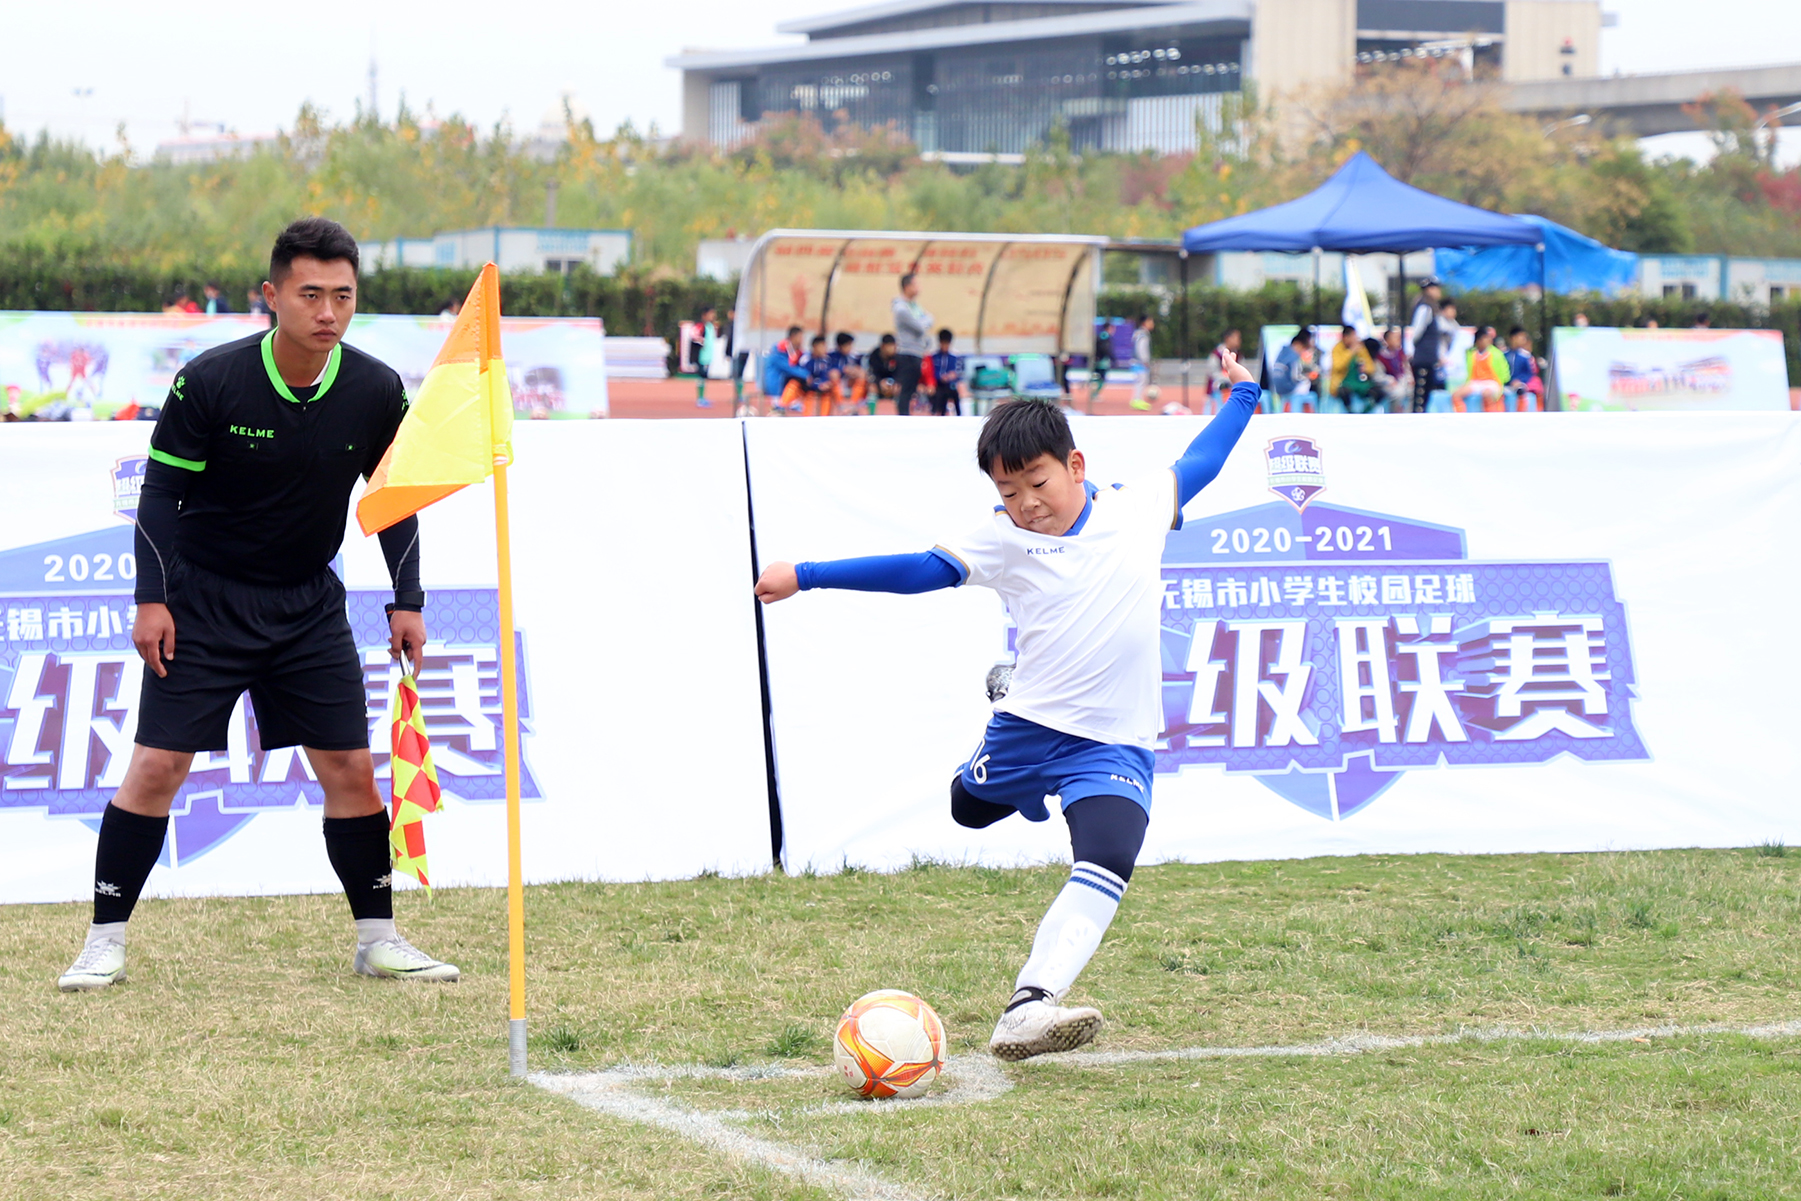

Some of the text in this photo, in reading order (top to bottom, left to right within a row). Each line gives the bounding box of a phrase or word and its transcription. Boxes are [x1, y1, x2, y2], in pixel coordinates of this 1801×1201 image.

[229, 425, 275, 438] KELME
[1026, 546, 1065, 555] KELME
[1210, 525, 1393, 554] 2020-2021
[43, 552, 137, 582] 2020
[1160, 573, 1476, 610] 无锡市小学生校园足球
[0, 605, 137, 641] 锡市小
[1148, 611, 1616, 749] 级联赛
[970, 737, 990, 784] 16
[1110, 773, 1144, 793] KELME
